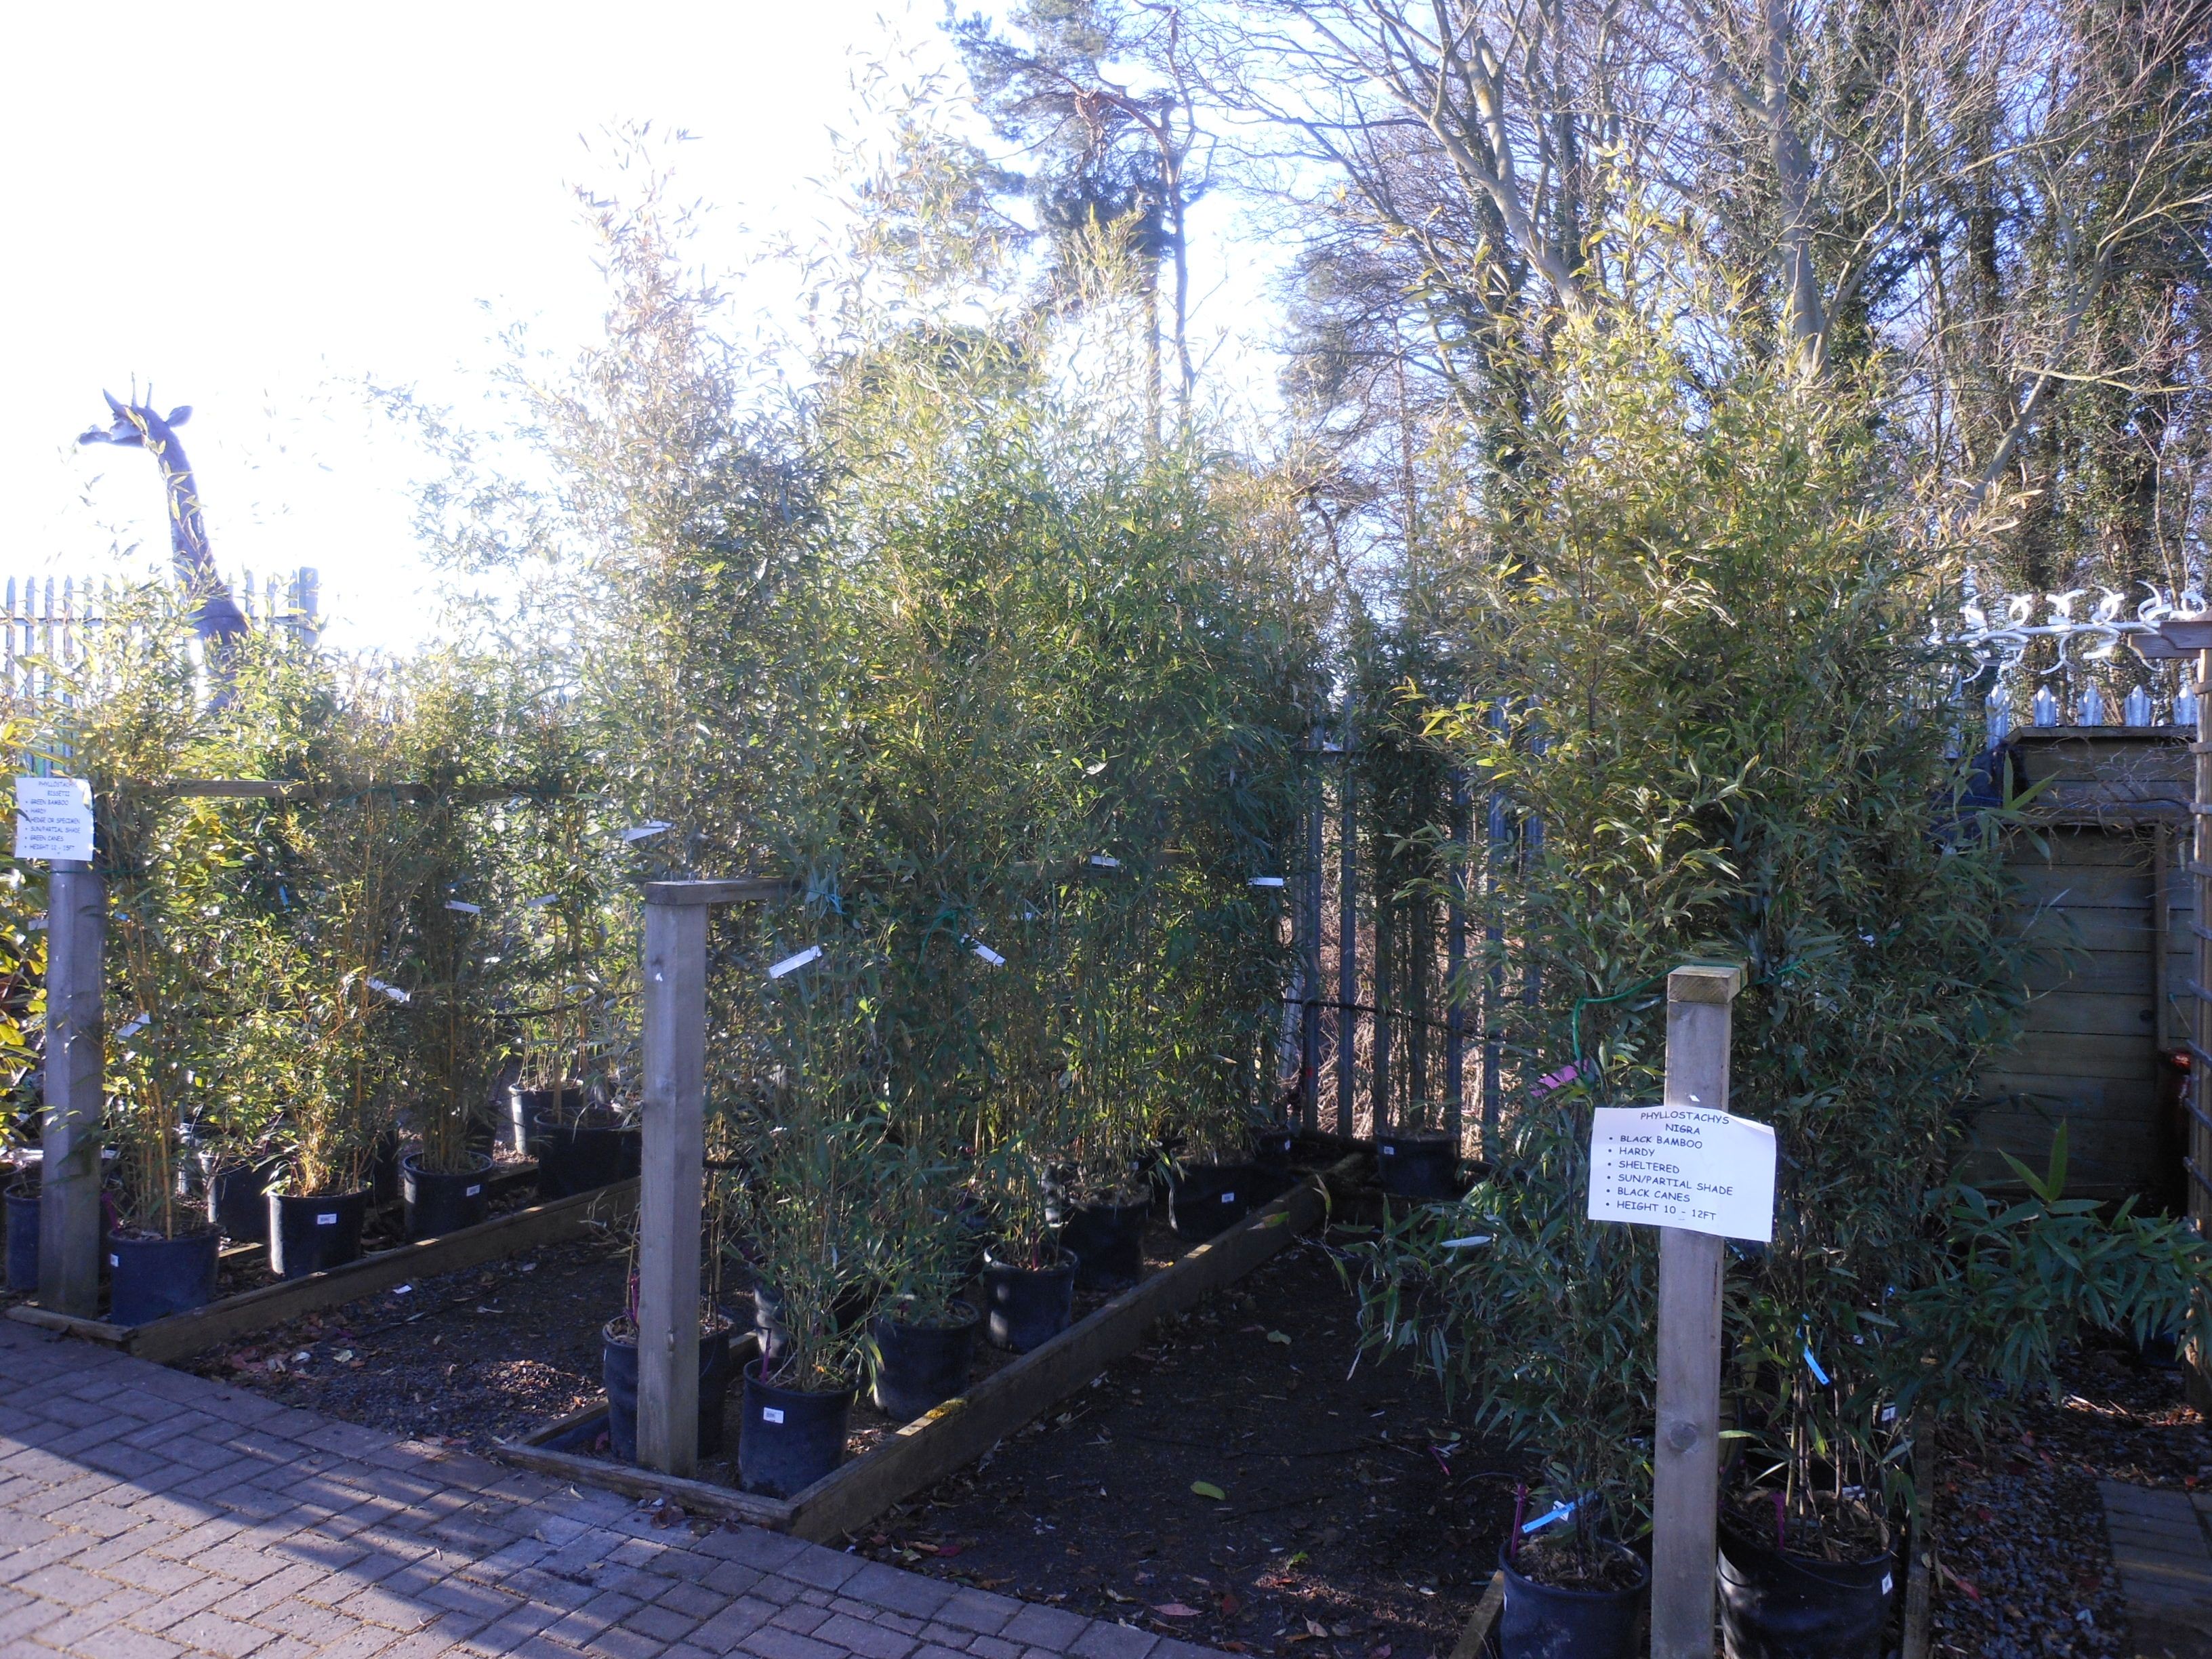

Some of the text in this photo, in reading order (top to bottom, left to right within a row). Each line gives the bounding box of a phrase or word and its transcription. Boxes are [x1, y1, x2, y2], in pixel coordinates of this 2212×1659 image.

[1640, 1111, 1729, 1125] PHYLLOSTACHYS
[1665, 1124, 1700, 1135] NIGRA
[1620, 1135, 1703, 1149] BLACK BAMBOO
[1619, 1147, 1655, 1157] HARDY
[1618, 1160, 1680, 1174] SHELTERED
[1618, 1174, 1734, 1196] SUN/PARTIAL SHADE
[1617, 1187, 1690, 1203] BLACK CANES
[1616, 1200, 1659, 1212] HEIGHT
[1664, 1205, 1676, 1214] 10
[1691, 1209, 1717, 1221] 12FT
